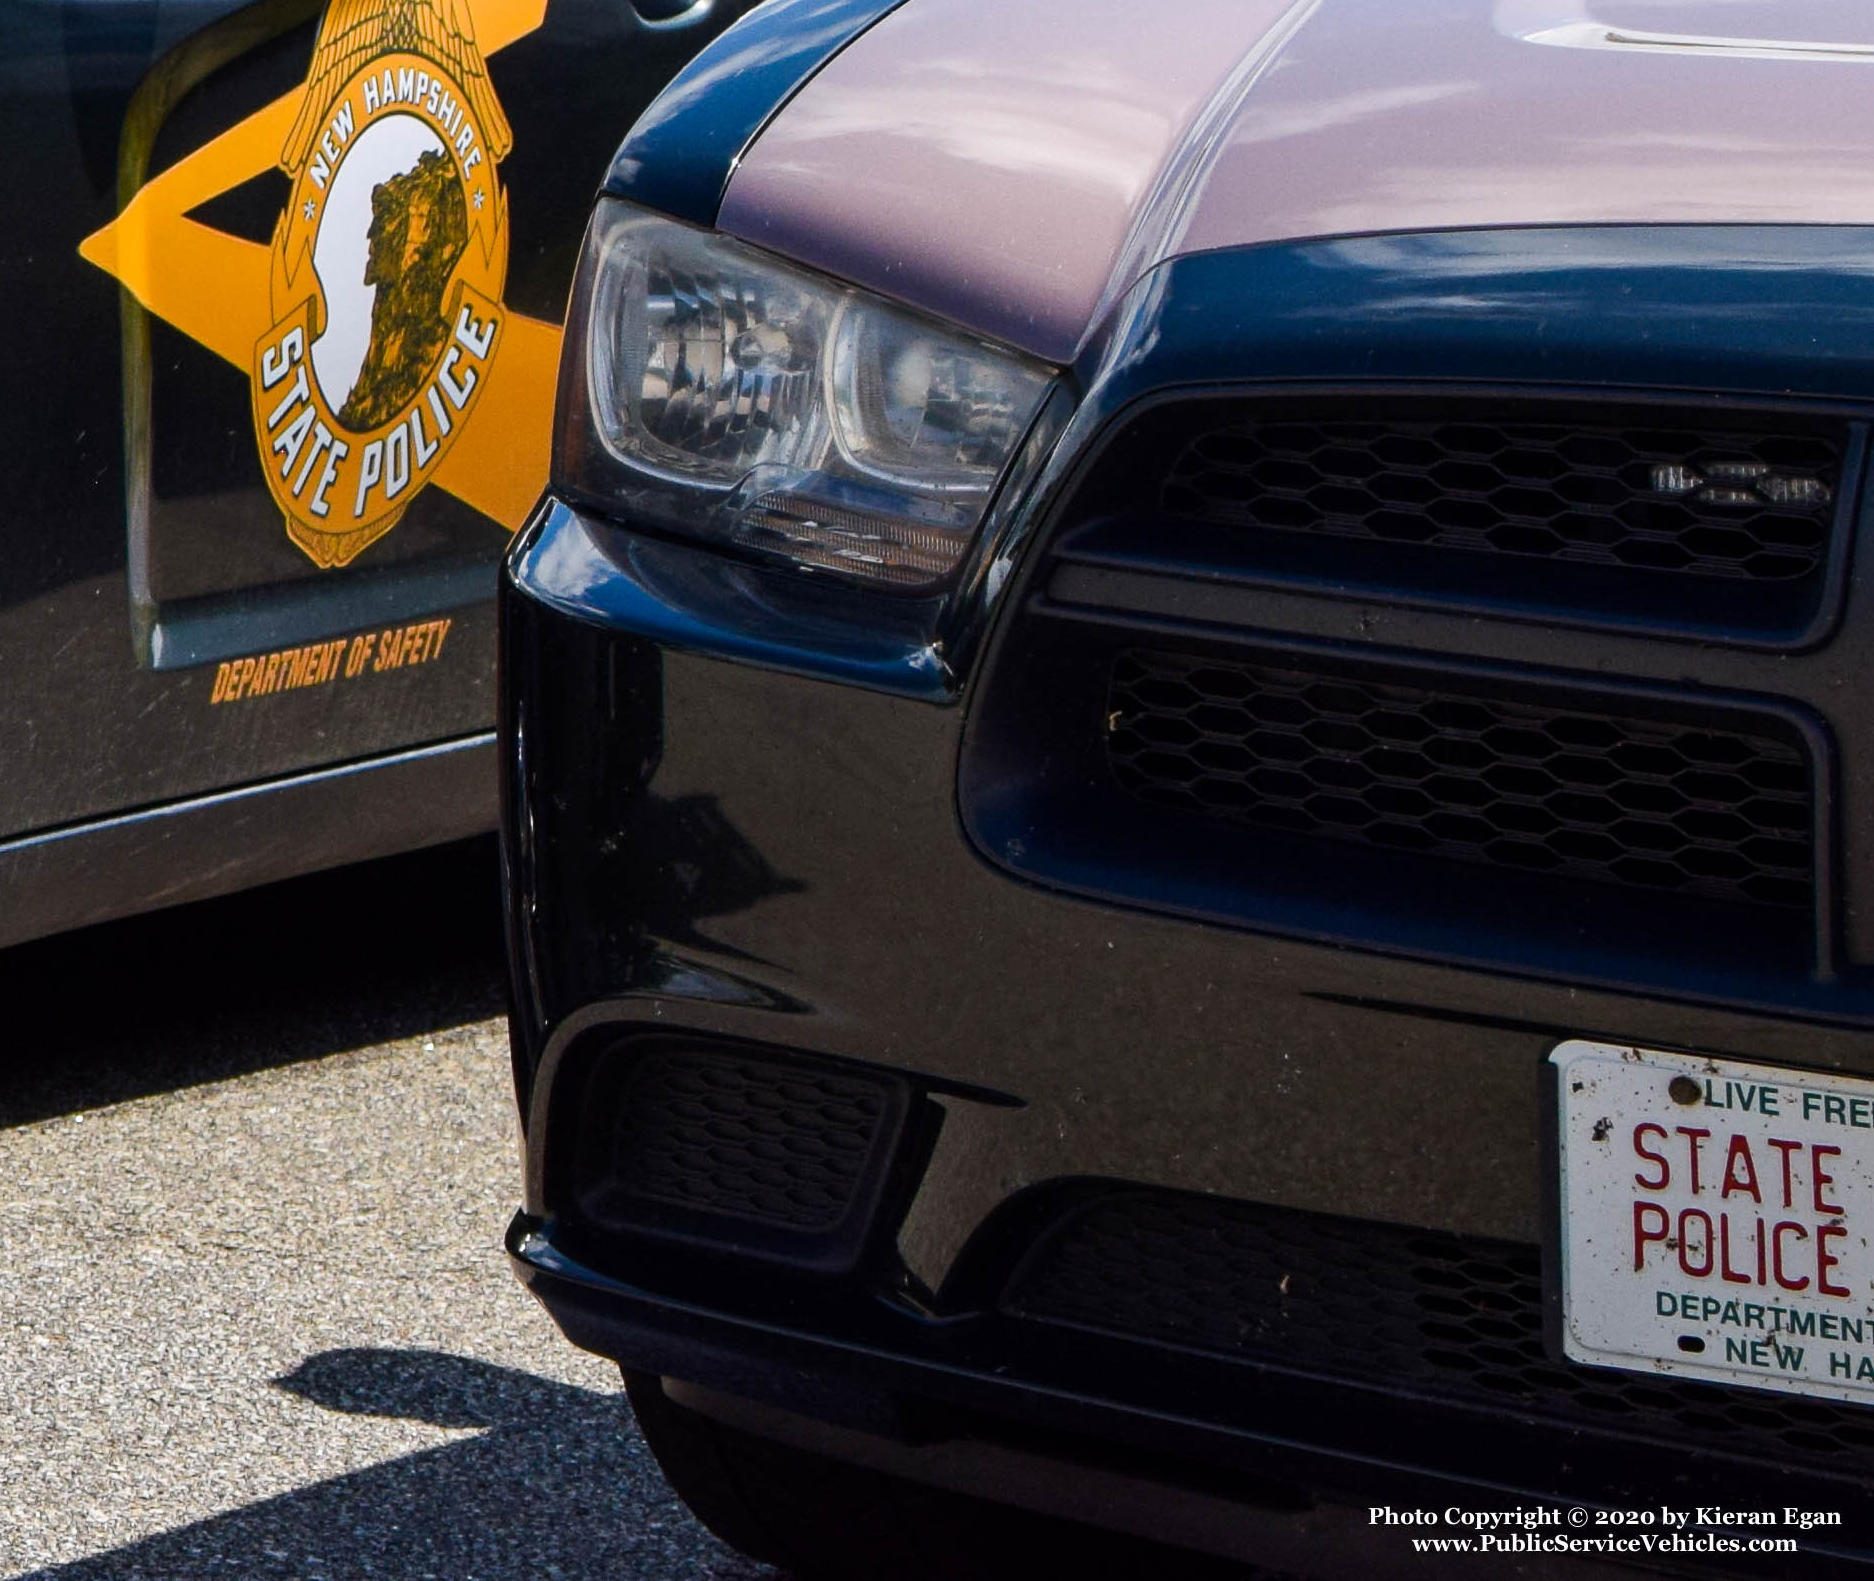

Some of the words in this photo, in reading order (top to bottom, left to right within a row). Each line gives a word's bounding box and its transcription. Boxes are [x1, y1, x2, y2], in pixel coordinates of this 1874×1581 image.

[309, 102, 355, 189] NEW
[362, 65, 483, 184] HAMPSHIRE
[262, 325, 350, 518] STATE
[354, 299, 498, 519] POLICE
[210, 638, 346, 706] DEPARTMENT
[345, 632, 375, 677] OF
[373, 618, 453, 673] SAFETY
[1703, 1078, 1780, 1116] LIVE
[1802, 1092, 1874, 1128] FRE
[1633, 1121, 1846, 1216] STATE
[1633, 1200, 1851, 1299] POLICE
[1725, 1337, 1806, 1372] NEW
